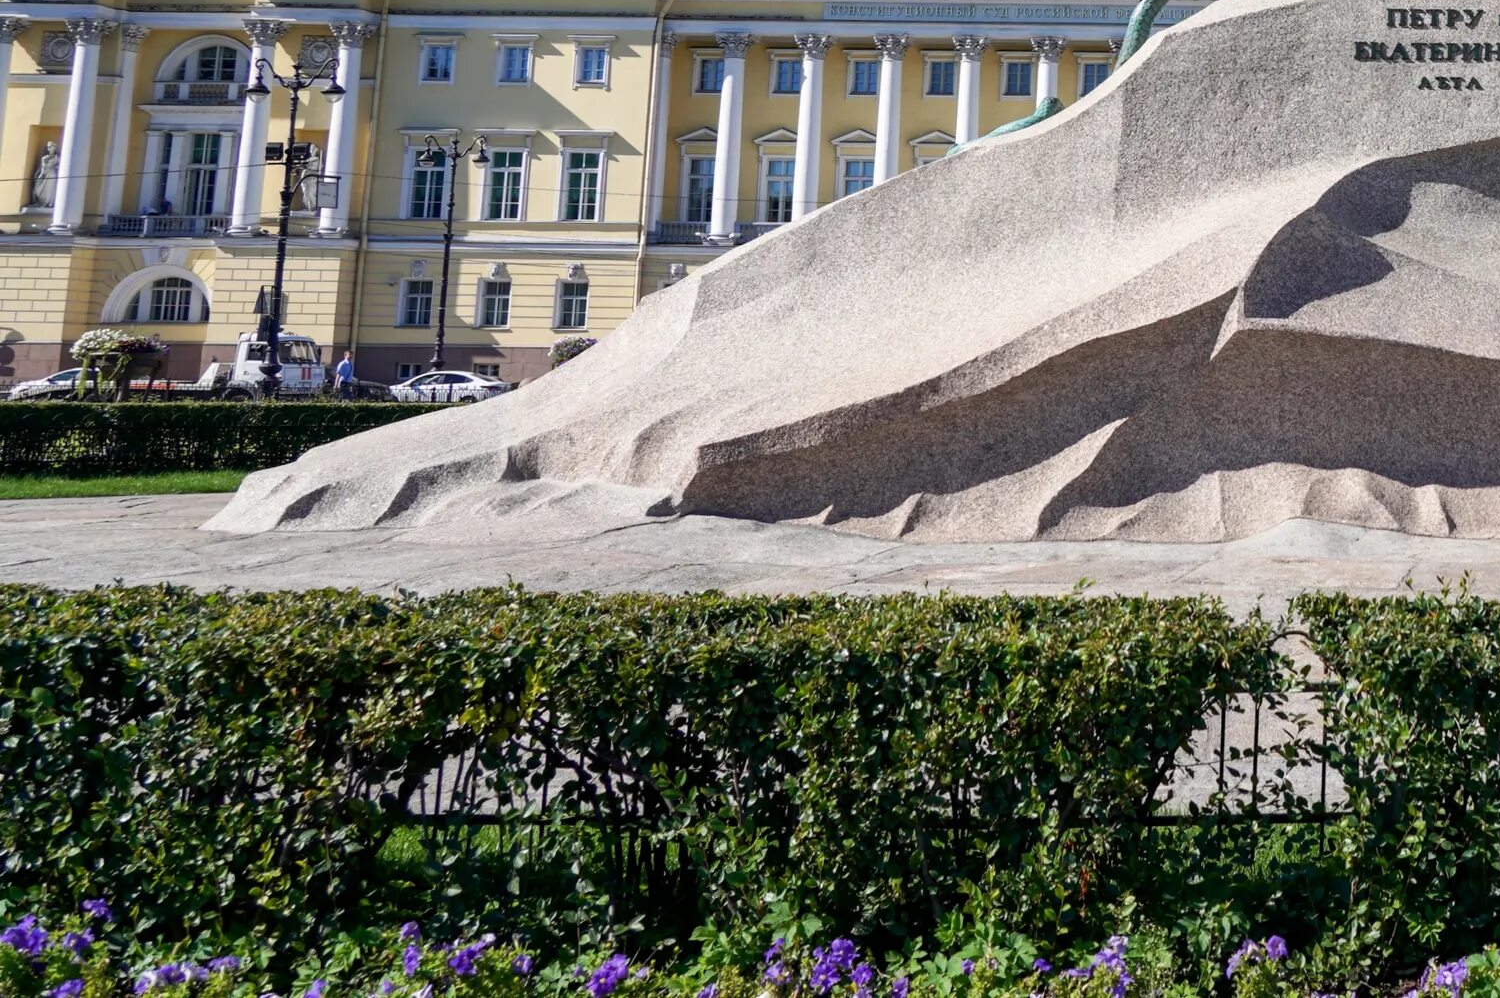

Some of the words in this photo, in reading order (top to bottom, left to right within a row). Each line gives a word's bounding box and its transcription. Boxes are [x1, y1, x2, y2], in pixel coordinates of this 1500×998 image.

[829, 4, 977, 17] КОНСТИТУЦИОННЫЙ
[983, 6, 1009, 19] СУД
[1015, 5, 1109, 19] РОССИЙСКОЙ
[1386, 8, 1484, 30] ПЕТРУ
